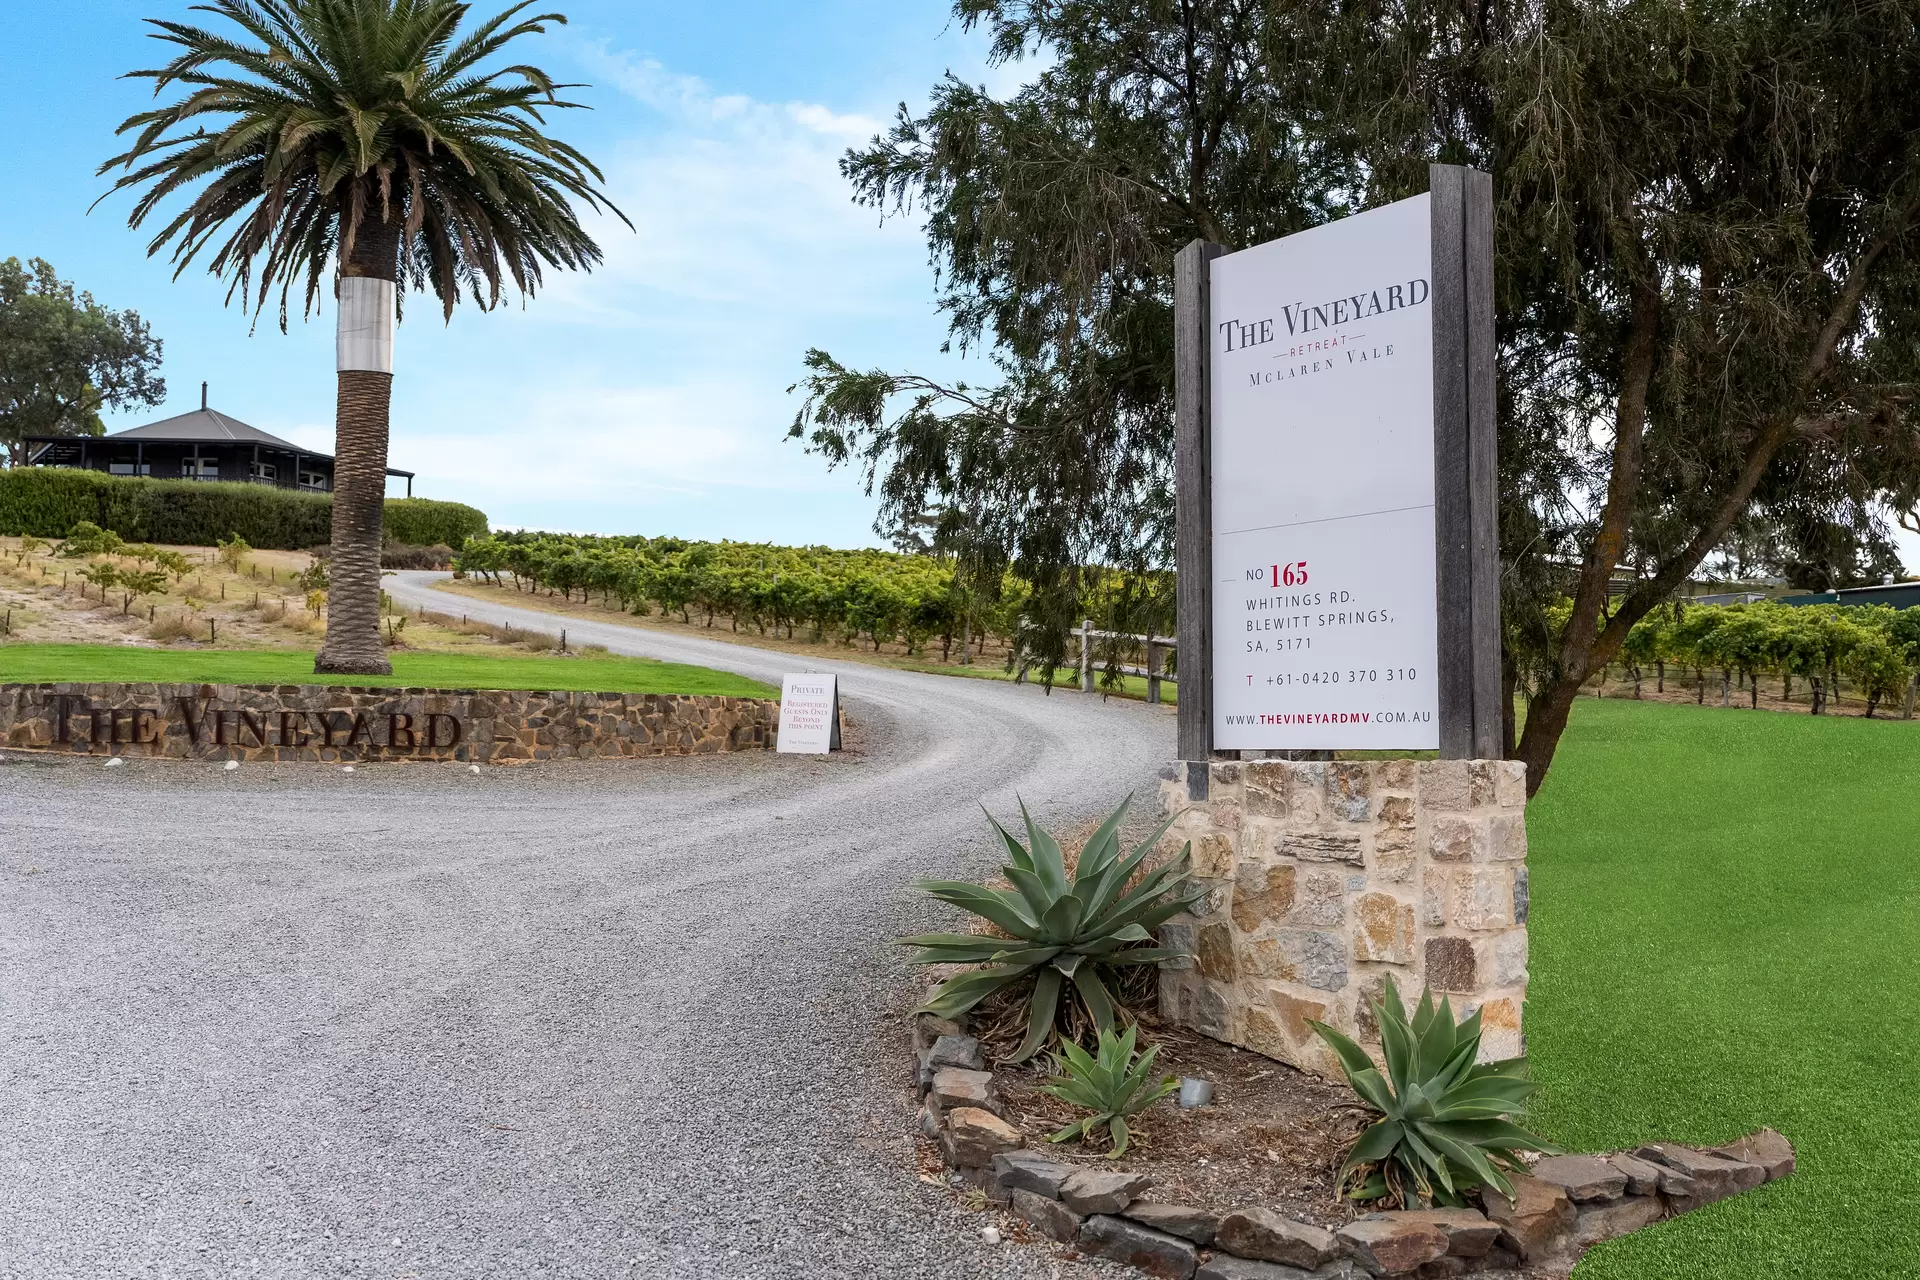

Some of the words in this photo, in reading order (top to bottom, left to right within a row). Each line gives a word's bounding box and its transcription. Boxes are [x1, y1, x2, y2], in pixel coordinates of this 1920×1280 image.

[1219, 318, 1274, 353] THE
[1281, 278, 1429, 336] VINEYARD
[1290, 335, 1347, 357] RETREAT
[1347, 344, 1394, 364] VALE
[1246, 568, 1264, 581] NO
[1270, 561, 1308, 588] 165
[1246, 593, 1321, 611] WHITINGS
[1330, 590, 1356, 603] RD.
[1246, 615, 1310, 632] BLEWITT
[1318, 609, 1395, 627] SPRINGS,
[1246, 640, 1269, 653] SA,
[1277, 637, 1312, 651] 5171
[1246, 675, 1253, 686] T
[1266, 672, 1340, 686] +61-0420
[1348, 669, 1377, 682] 370
[1386, 667, 1416, 681] 310
[791, 684, 825, 694] PRIVATE
[43, 694, 158, 744] THE
[174, 695, 462, 748] VINEYARD
[1225, 711, 1431, 725] WWW.THEVINEYARDMV.COM.AU
